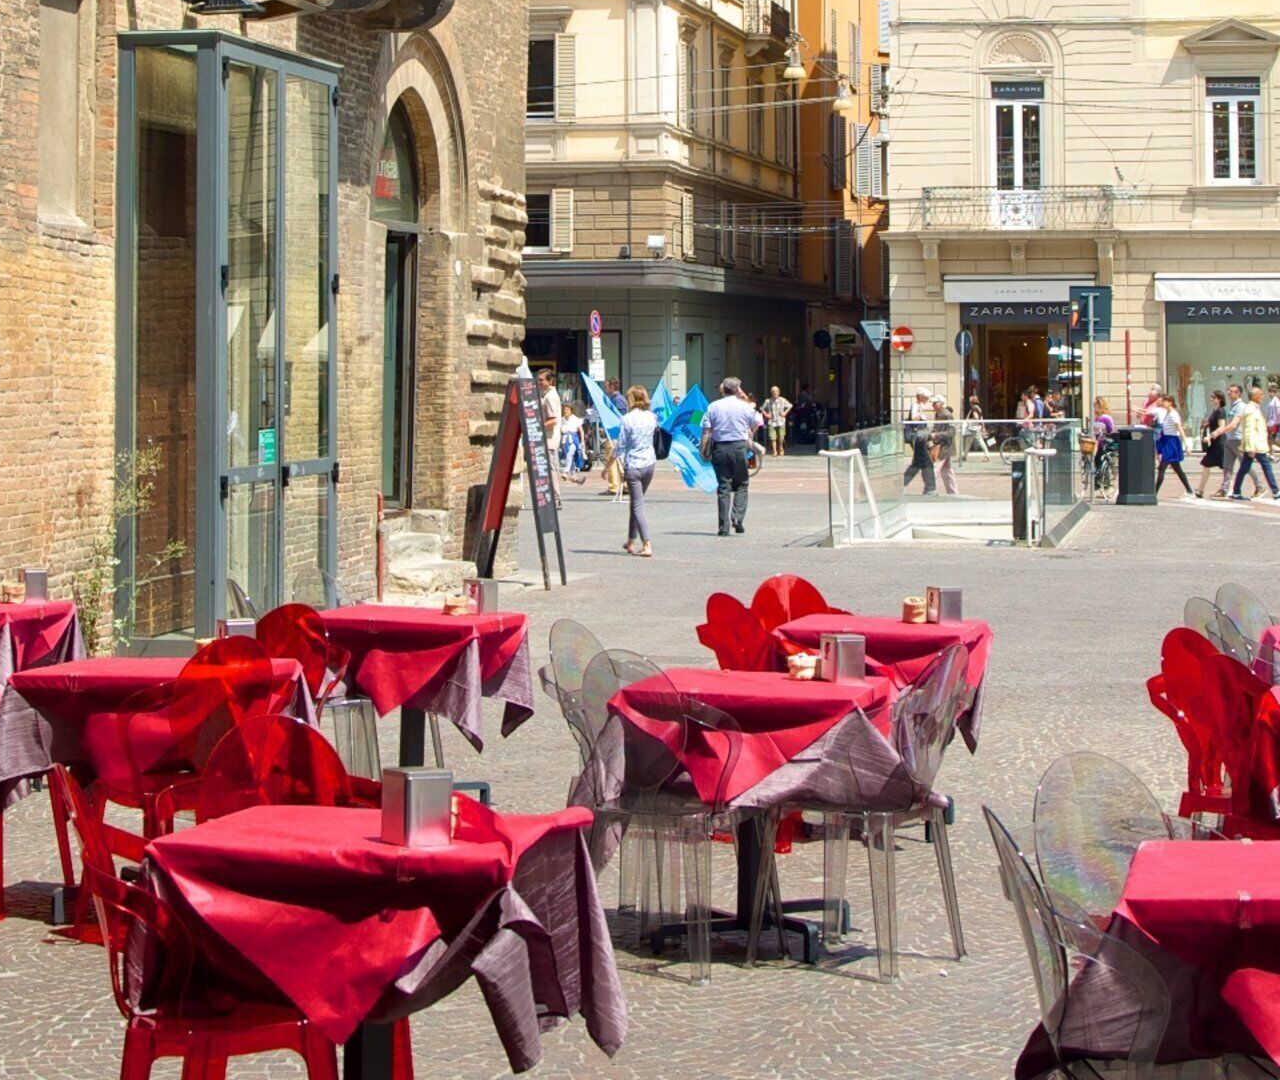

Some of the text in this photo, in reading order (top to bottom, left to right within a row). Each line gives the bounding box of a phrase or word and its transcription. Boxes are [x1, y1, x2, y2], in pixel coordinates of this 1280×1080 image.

[970, 305, 1070, 316] ZARA HOME
[1186, 306, 1234, 316] ZARA
